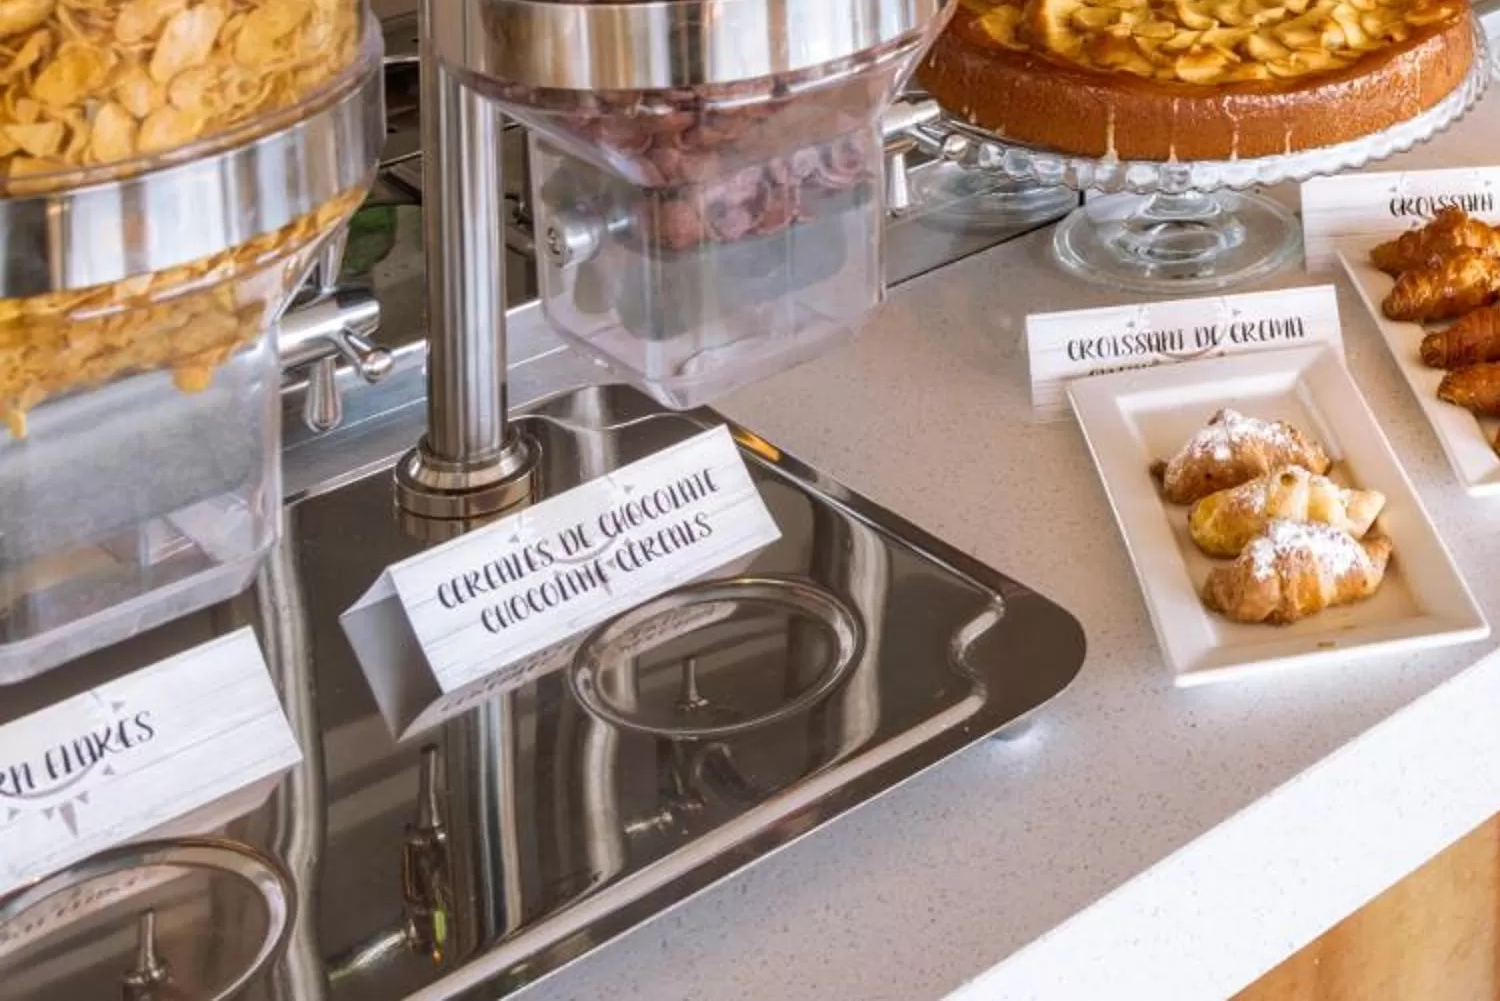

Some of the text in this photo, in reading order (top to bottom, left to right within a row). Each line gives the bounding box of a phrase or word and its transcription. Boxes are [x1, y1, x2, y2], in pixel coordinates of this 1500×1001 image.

[1067, 316, 1305, 361] CROISSANT DE CREMA
[437, 467, 720, 609] CEREALES DE CHOCOLATE
[480, 511, 713, 634] CHOCOLATE CEREALS
[44, 710, 154, 780] FLAKES
